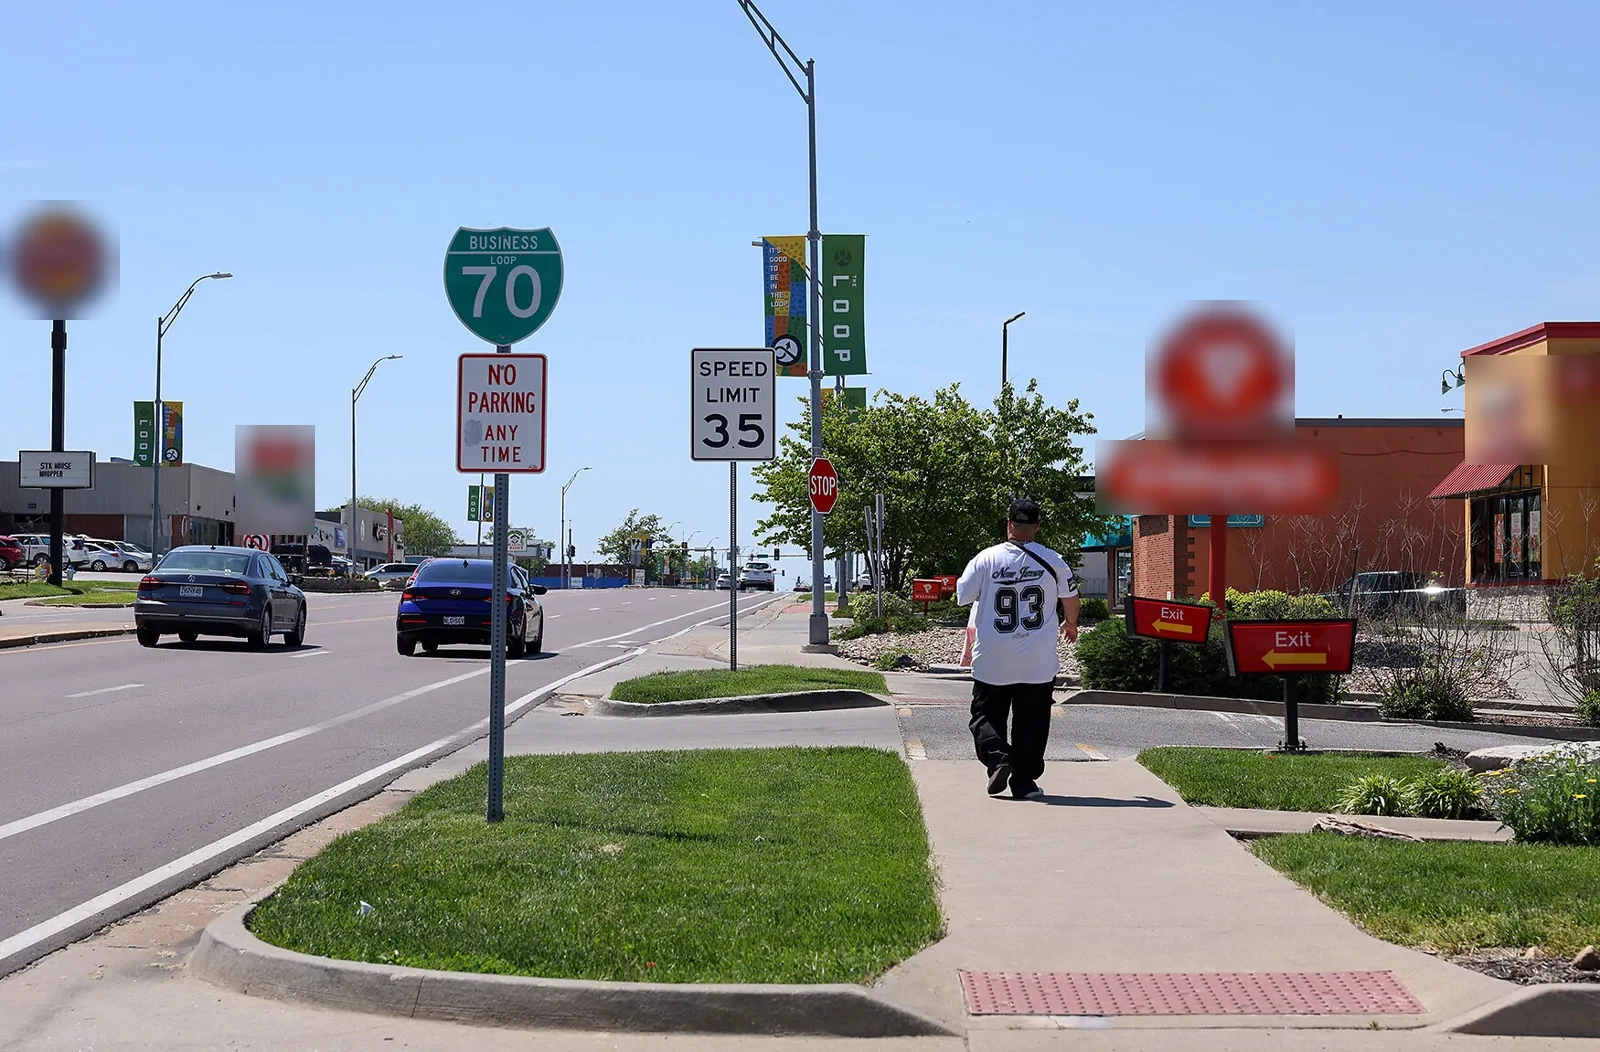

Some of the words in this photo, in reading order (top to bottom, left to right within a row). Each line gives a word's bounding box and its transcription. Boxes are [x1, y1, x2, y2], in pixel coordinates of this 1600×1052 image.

[469, 235, 538, 250] BUSINESS
[490, 255, 517, 265] LOOP
[462, 264, 542, 319] 70
[832, 275, 851, 362] LOOP
[488, 364, 516, 385] NO
[699, 361, 768, 377] SPEED
[468, 391, 535, 414] PARKING
[706, 387, 761, 403] LIMIT
[139, 420, 148, 461] LOOP
[484, 425, 518, 441] ANY
[701, 413, 765, 449] 35
[481, 446, 521, 463] TIME
[811, 475, 835, 497] STOP
[993, 585, 1045, 634] 93
[1161, 606, 1185, 621] Exit
[1275, 631, 1311, 647] Exit
